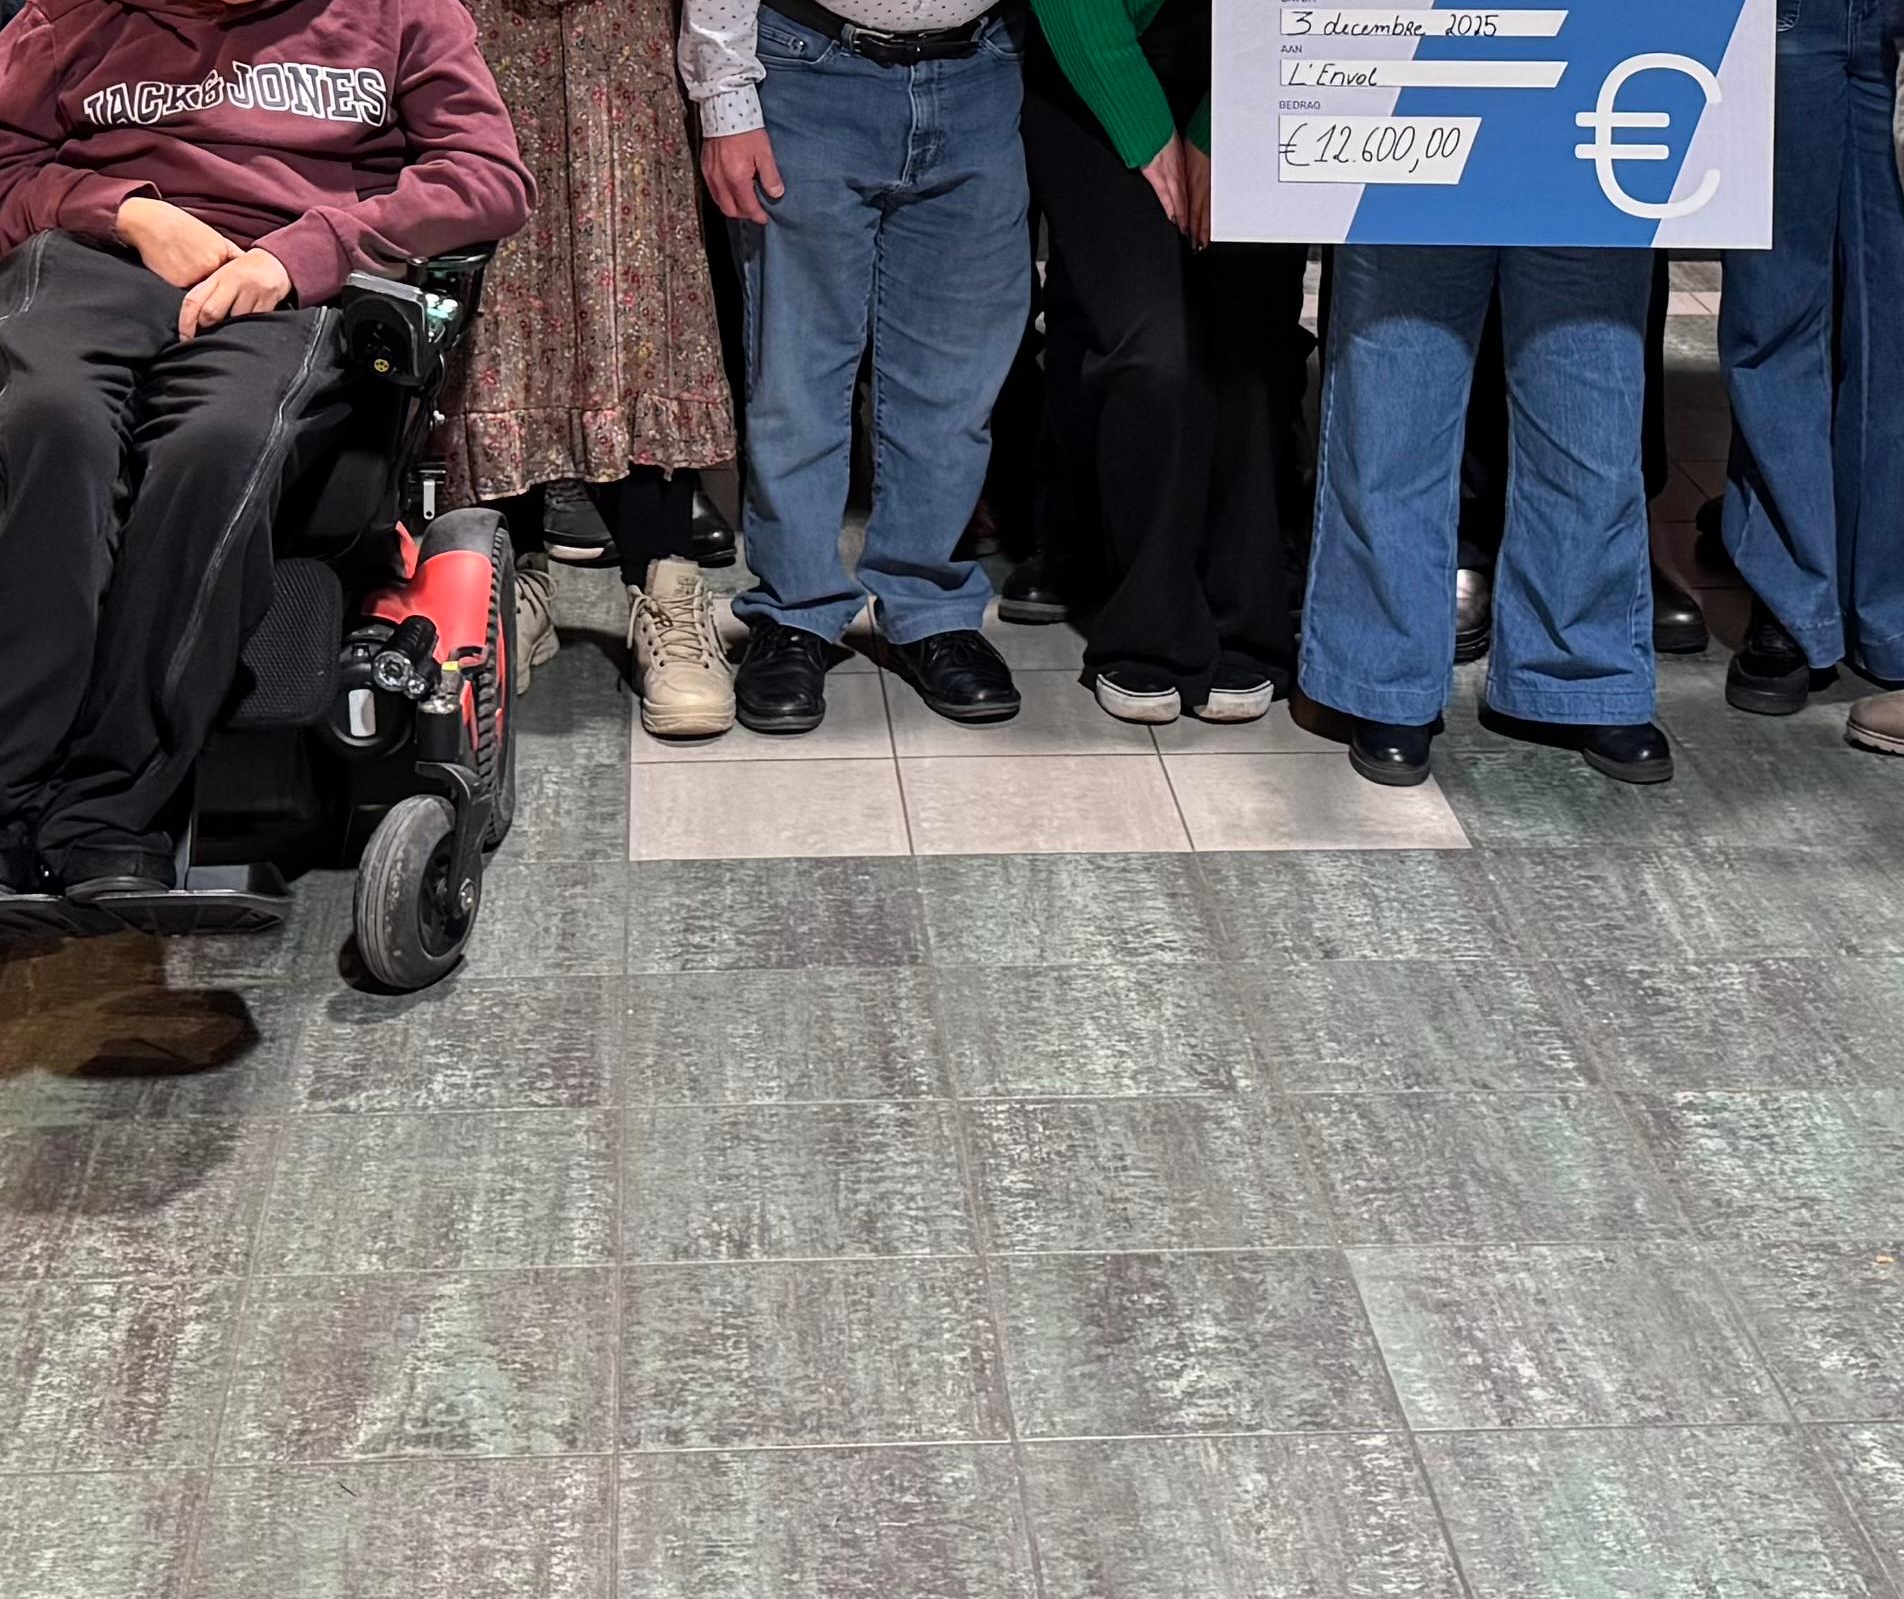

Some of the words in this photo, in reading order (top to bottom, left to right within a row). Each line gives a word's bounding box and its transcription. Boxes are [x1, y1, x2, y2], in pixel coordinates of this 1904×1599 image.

[1287, 11, 1313, 35] 3
[1281, 45, 1302, 53] AAN
[1289, 62, 1378, 86] L'Envol
